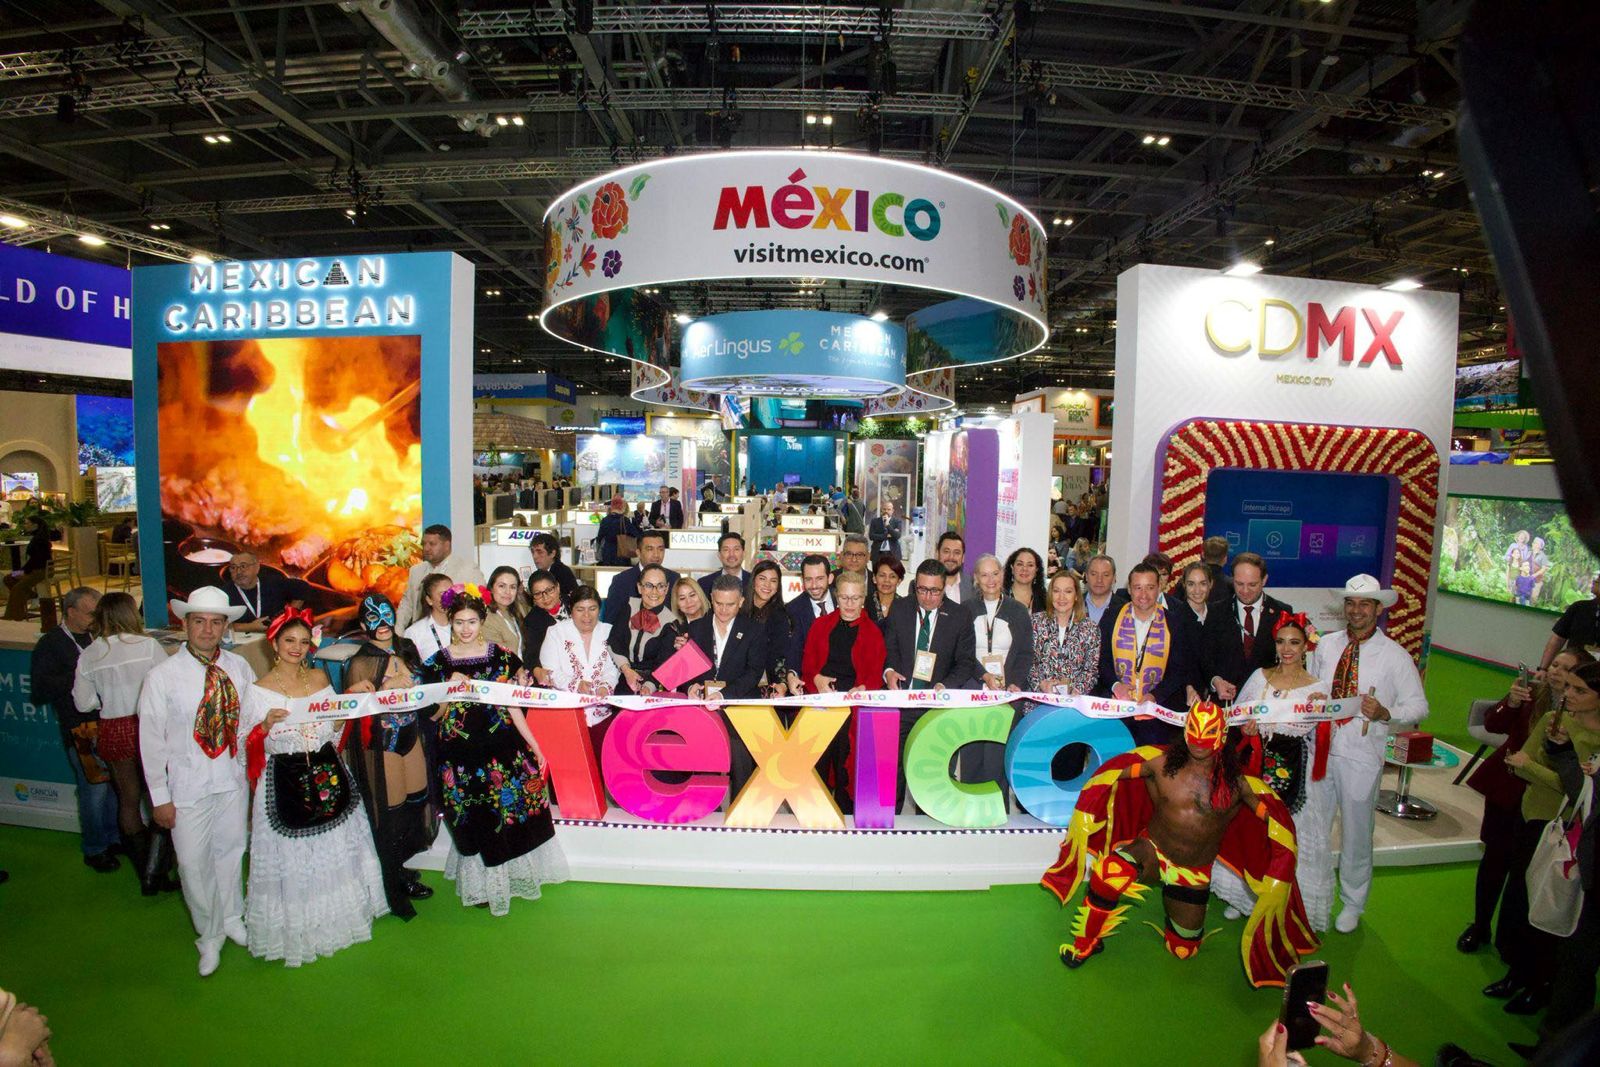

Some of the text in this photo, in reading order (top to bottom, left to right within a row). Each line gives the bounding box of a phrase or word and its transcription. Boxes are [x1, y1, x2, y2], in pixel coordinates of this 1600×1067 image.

[734, 242, 925, 273] visitmexico.com
[189, 256, 384, 293] MEXICAN
[55, 285, 98, 314] OF
[163, 294, 414, 332] CARIBBEAN
[715, 338, 772, 360] Lingus
[1206, 299, 1405, 370] CDMX
[1276, 374, 1335, 387] MEXICO CITY
[669, 441, 681, 480] TULUM
[671, 533, 719, 544] KARISM
